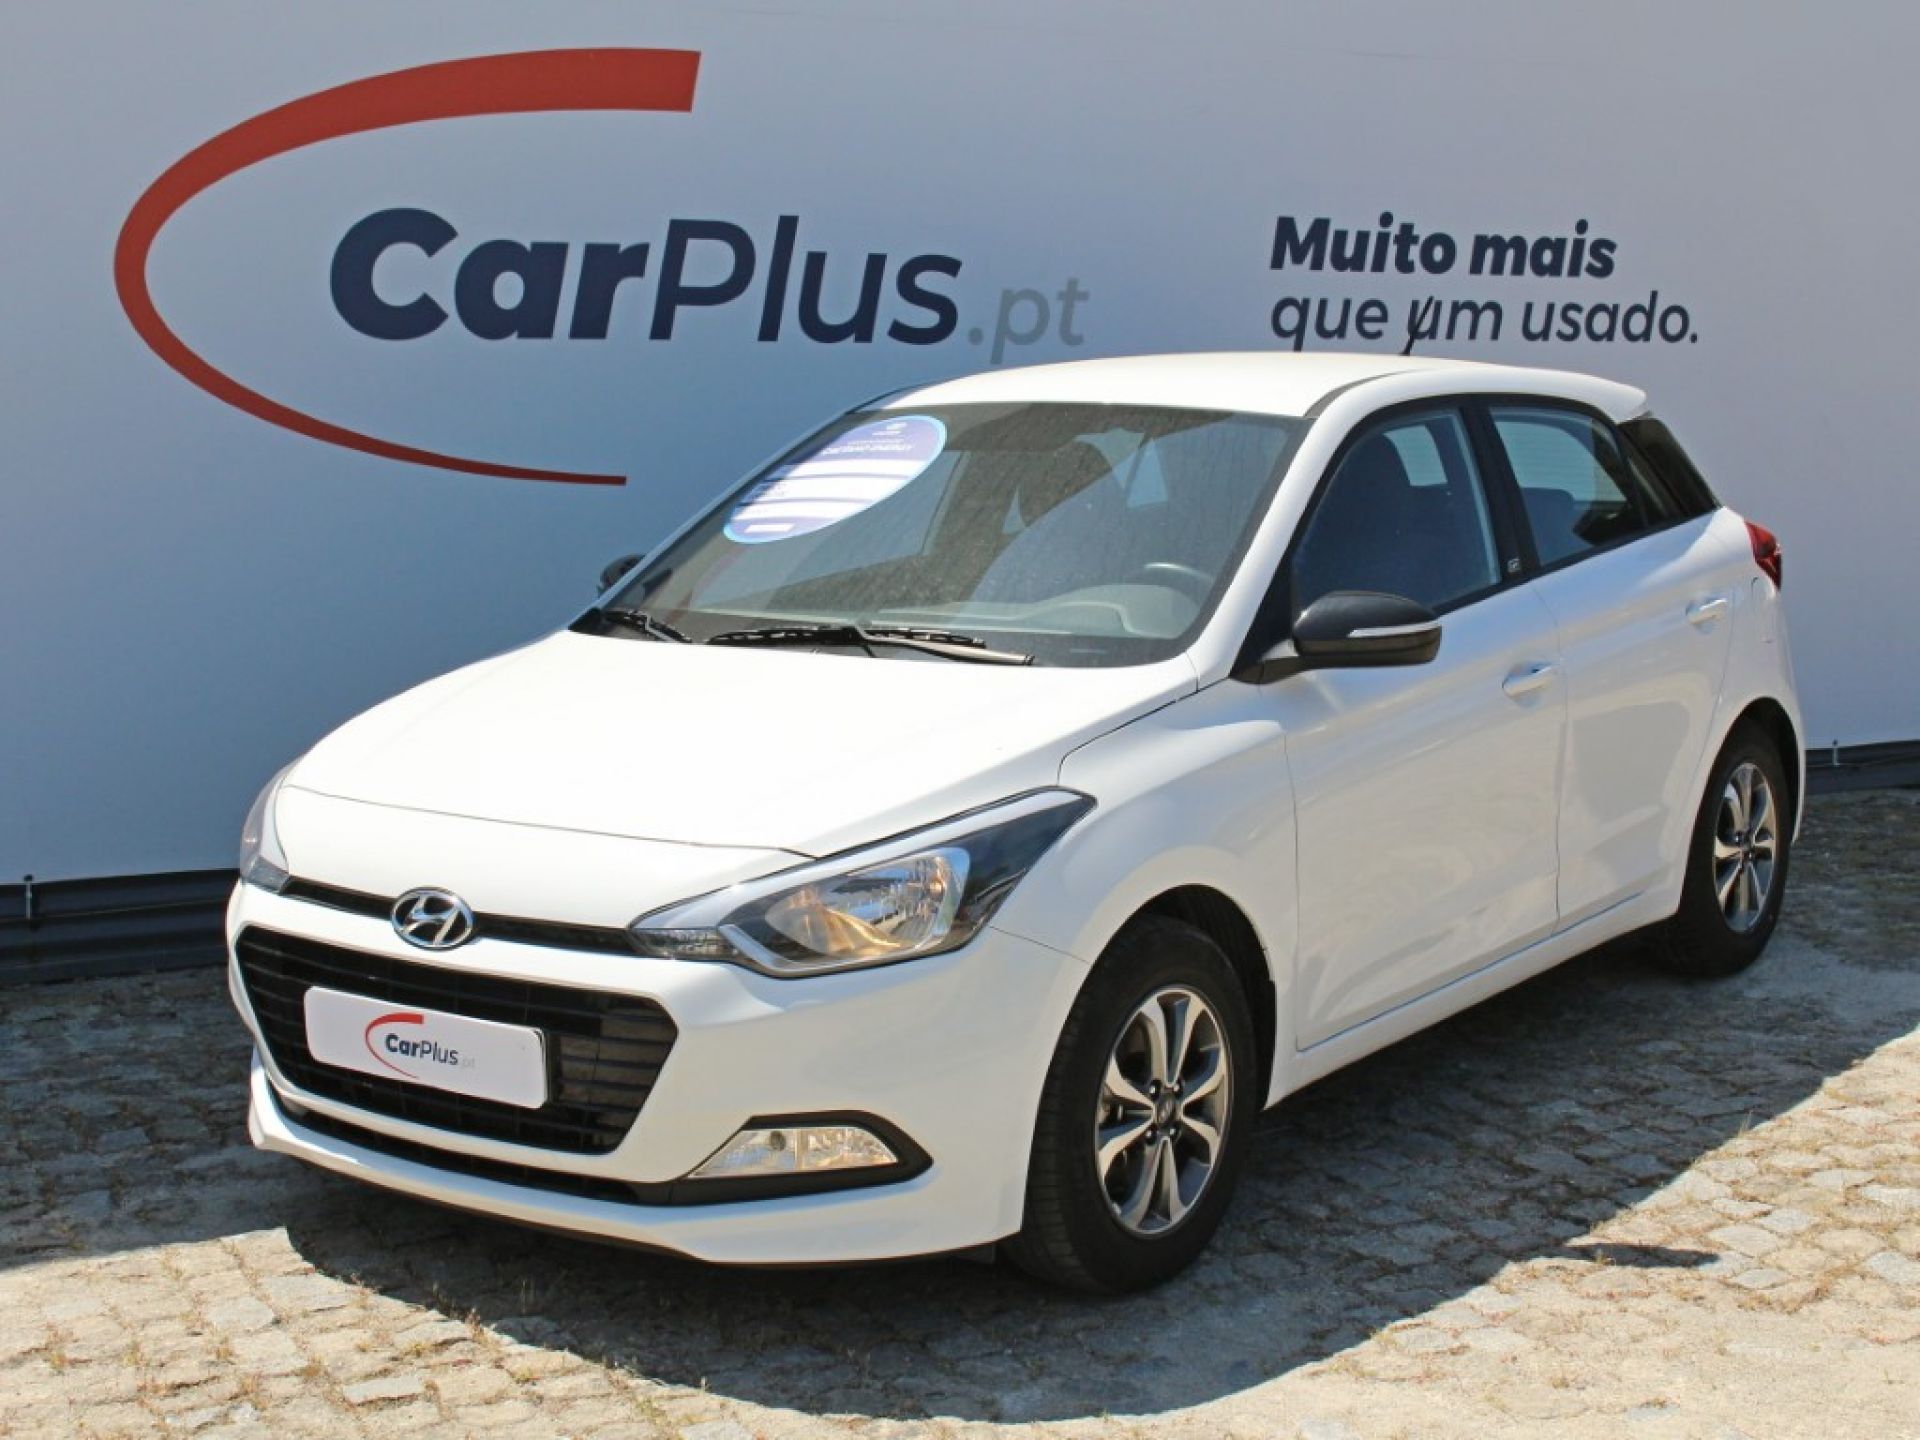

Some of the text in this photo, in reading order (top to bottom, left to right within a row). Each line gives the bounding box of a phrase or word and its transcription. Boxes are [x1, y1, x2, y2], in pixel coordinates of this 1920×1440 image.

[1270, 211, 1618, 279] Muito mais
[1271, 290, 1699, 352] que um usado.
